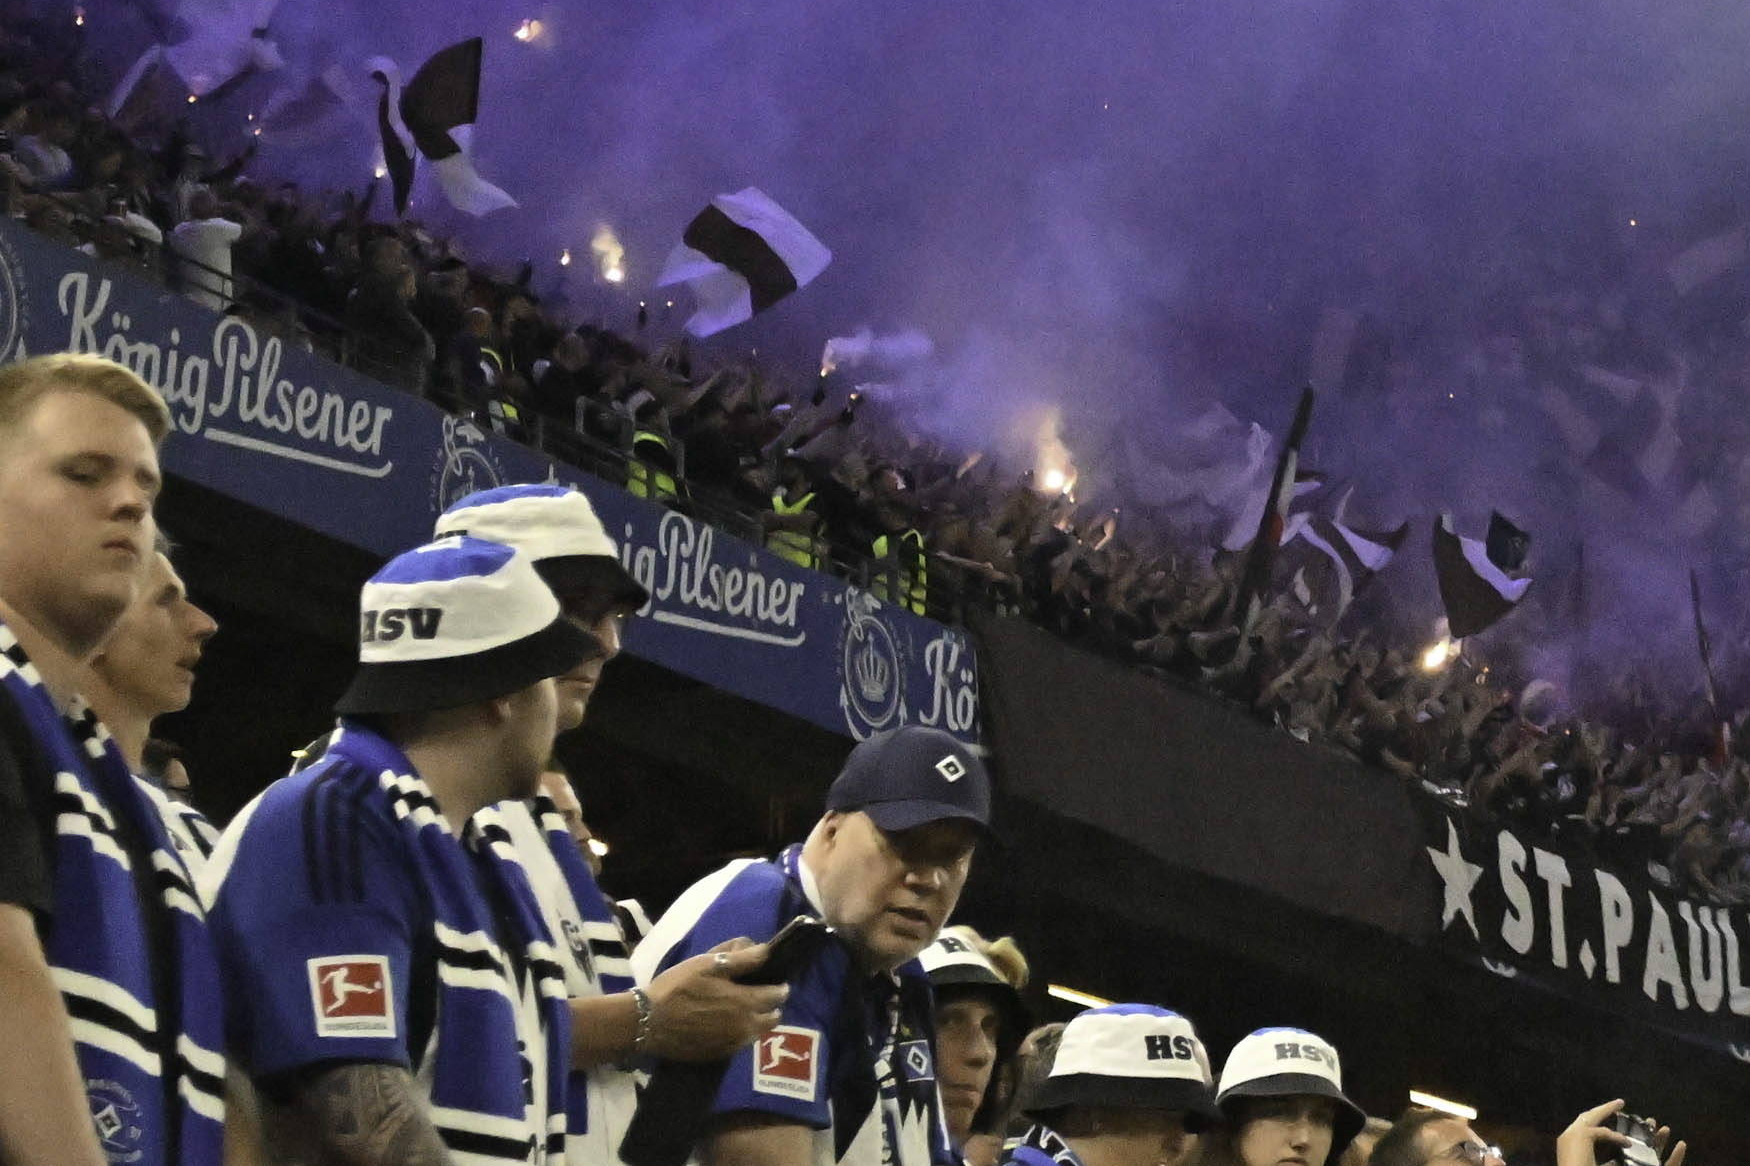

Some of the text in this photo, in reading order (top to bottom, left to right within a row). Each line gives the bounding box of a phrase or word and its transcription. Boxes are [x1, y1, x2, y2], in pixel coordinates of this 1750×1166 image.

[208, 314, 393, 456] Pilsener
[656, 510, 804, 627] Pilsener
[1275, 1042, 1335, 1072] HSV
